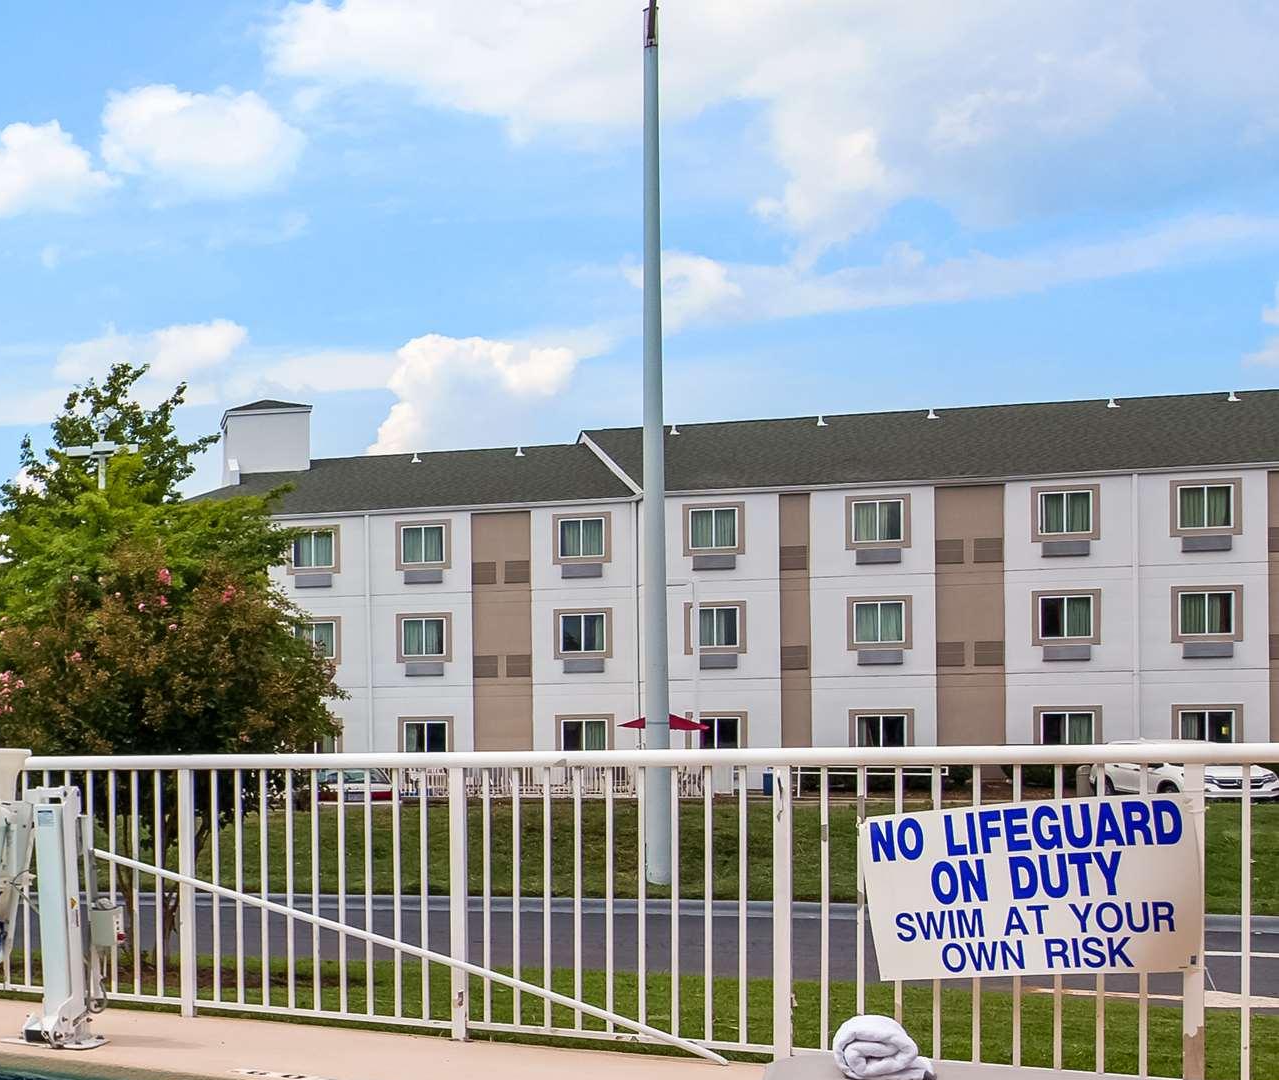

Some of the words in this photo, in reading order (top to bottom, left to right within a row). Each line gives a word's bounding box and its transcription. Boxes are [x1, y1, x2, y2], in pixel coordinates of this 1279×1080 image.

[870, 817, 924, 862] NO
[944, 799, 1183, 857] LIFEGUARD
[931, 858, 989, 905] ON
[1008, 851, 1122, 900] DUTY
[895, 908, 984, 942] SWIM
[1004, 904, 1049, 936] AT
[1068, 901, 1176, 934] YOUR
[942, 939, 1026, 973] OWN
[1044, 936, 1135, 969] RISK
